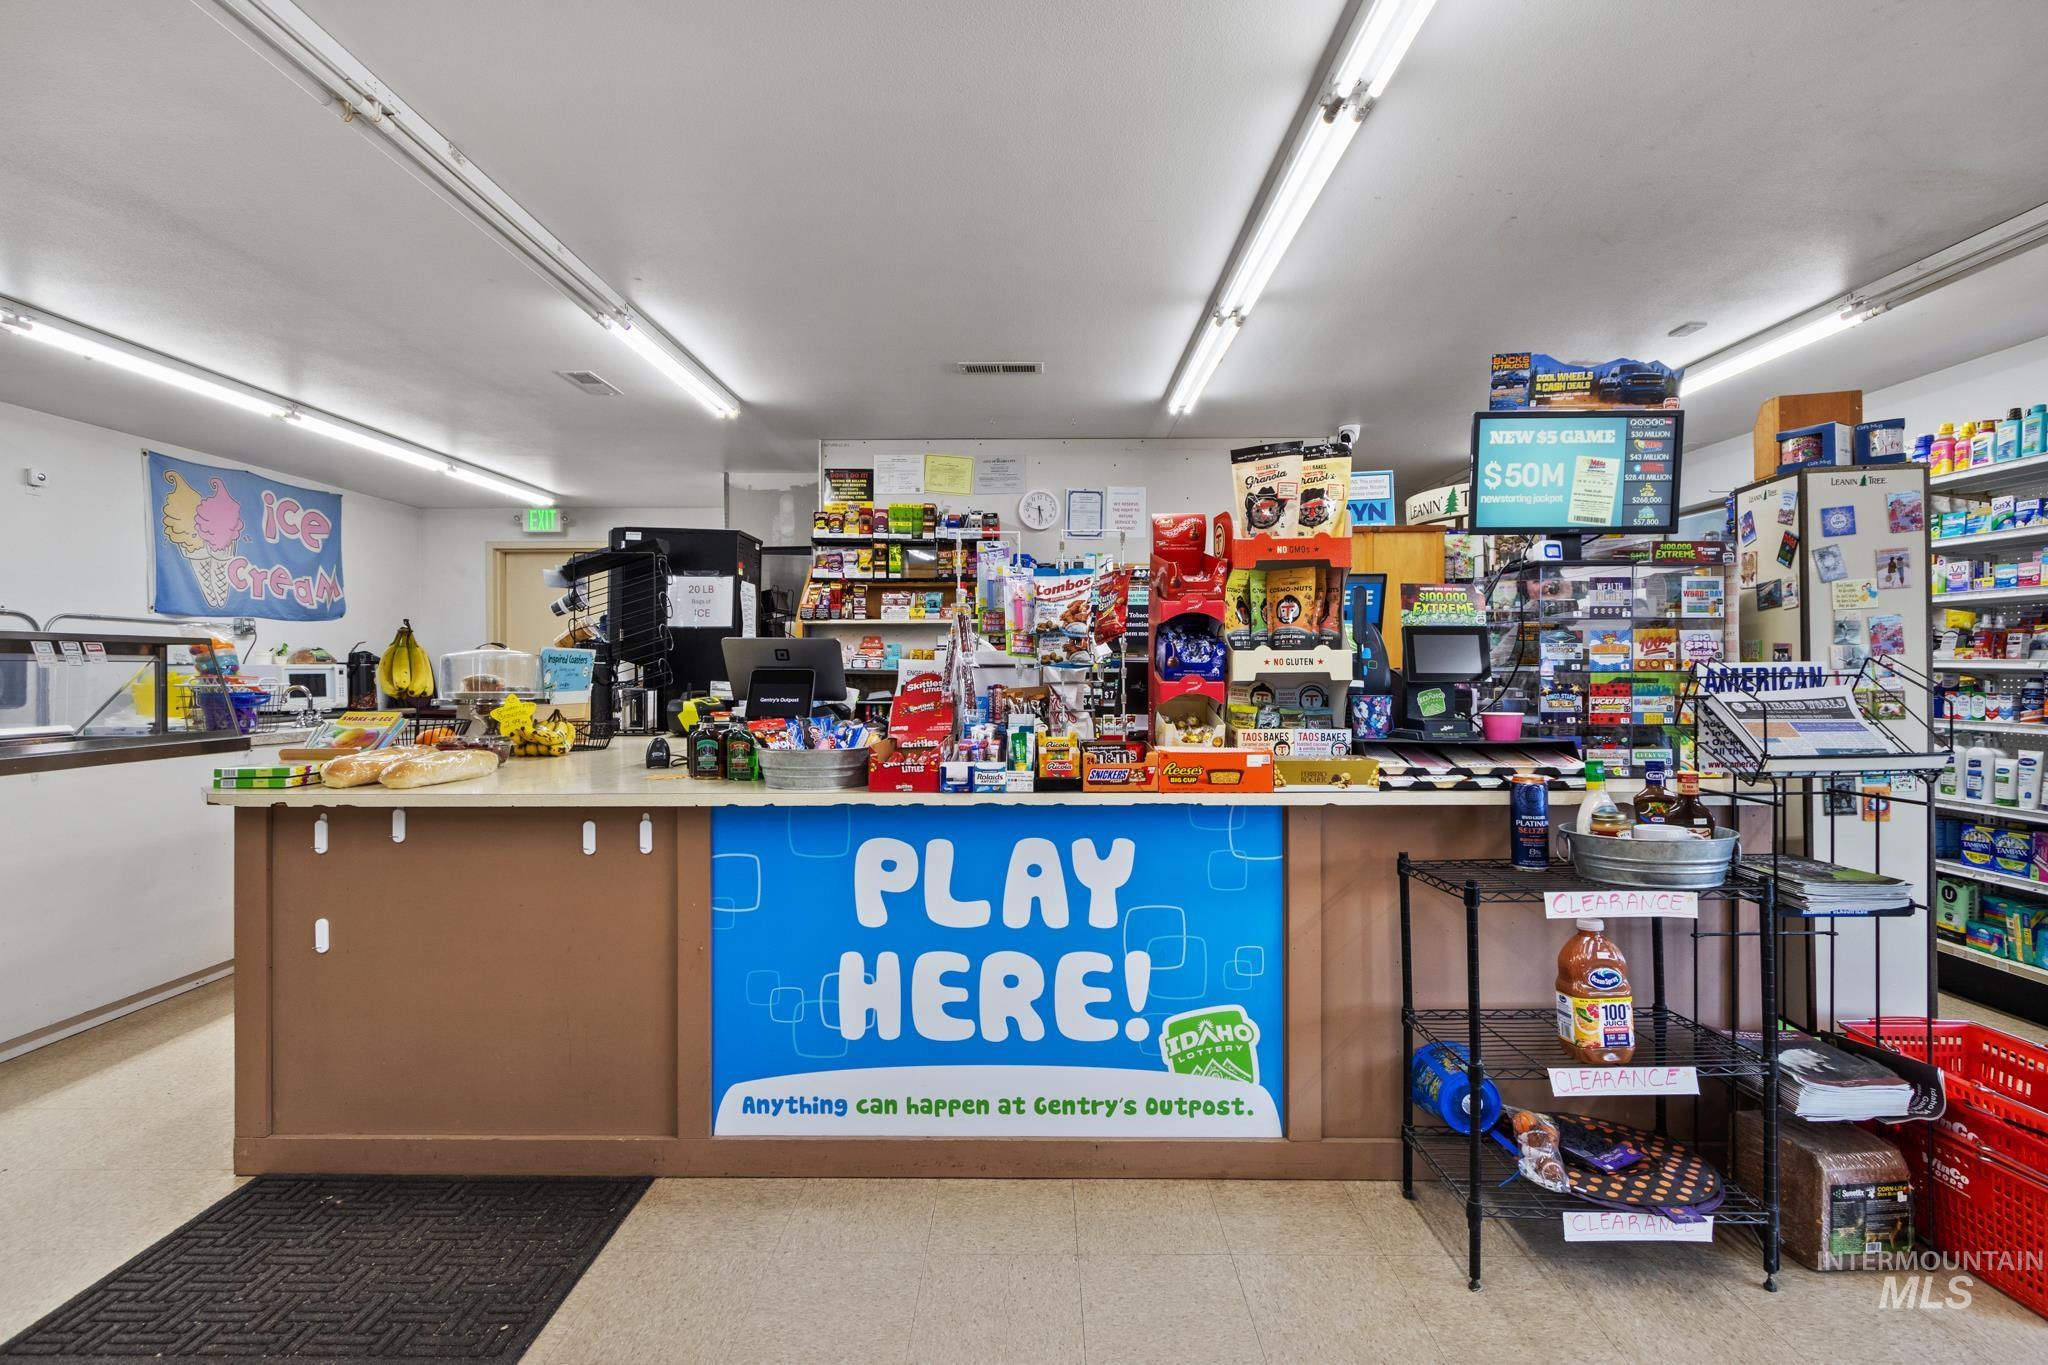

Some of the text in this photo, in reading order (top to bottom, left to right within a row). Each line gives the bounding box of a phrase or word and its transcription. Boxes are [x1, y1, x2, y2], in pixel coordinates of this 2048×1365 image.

[1493, 356, 1530, 364] BUCKS
[1536, 372, 1593, 382] COOL WHEELS
[1542, 382, 1566, 391] CASH
[1567, 382, 1590, 390] DEALS
[1490, 430, 1616, 445] NEW $5 GAME
[1245, 470, 1288, 490] Granola
[1302, 473, 1337, 485] ranola
[1484, 460, 1565, 490] $50M
[1831, 477, 1887, 486] LEANIN TREE
[1480, 495, 1500, 504] new
[1500, 493, 1531, 505] starting
[1532, 493, 1564, 505] jackpot
[1346, 502, 1387, 521] YN
[1410, 496, 1443, 520] LEANIN'
[528, 509, 557, 531] EXIT
[1633, 518, 1659, 526] $57,800
[1277, 546, 1288, 554] NO
[1656, 550, 1697, 560] EXTREME
[688, 585, 715, 594] 20 LB
[1034, 577, 1091, 596] Combos
[1270, 586, 1313, 594] COSMO-NUTS
[1596, 583, 1623, 591] WEALTH
[1419, 592, 1468, 603] $100,000
[1683, 590, 1704, 598] WORD
[1412, 602, 1475, 616] EXTREME
[1689, 634, 1711, 642] BIG
[1274, 658, 1314, 666] NO GLUTEN
[1704, 667, 1823, 693] AMERICAN
[907, 681, 943, 692] Skittles
[1242, 732, 1347, 742] TAOS BAKES TAOS BAKES
[902, 739, 939, 748] Skittles
[1046, 741, 1069, 749] Ricola
[1047, 763, 1073, 771] Ricola
[1163, 763, 1203, 776] Reese's
[977, 773, 1004, 781] Rolaids
[1089, 769, 1128, 780] SNICKERS
[1997, 848, 2028, 856] TAMPAX
[854, 837, 1136, 929] PLAY
[1553, 893, 1685, 914] CLEARANCE
[1591, 975, 1619, 985] Ocean Spray
[839, 951, 1152, 1042] HERE!
[1166, 1022, 1254, 1057] IDAHO
[1178, 1044, 1244, 1063] LOTTERY
[1554, 1068, 1681, 1094] CLEARANCE
[742, 1096, 1255, 1118] Anything can happen at Gentry's Outpost.
[1932, 1168, 1964, 1190] OODS
